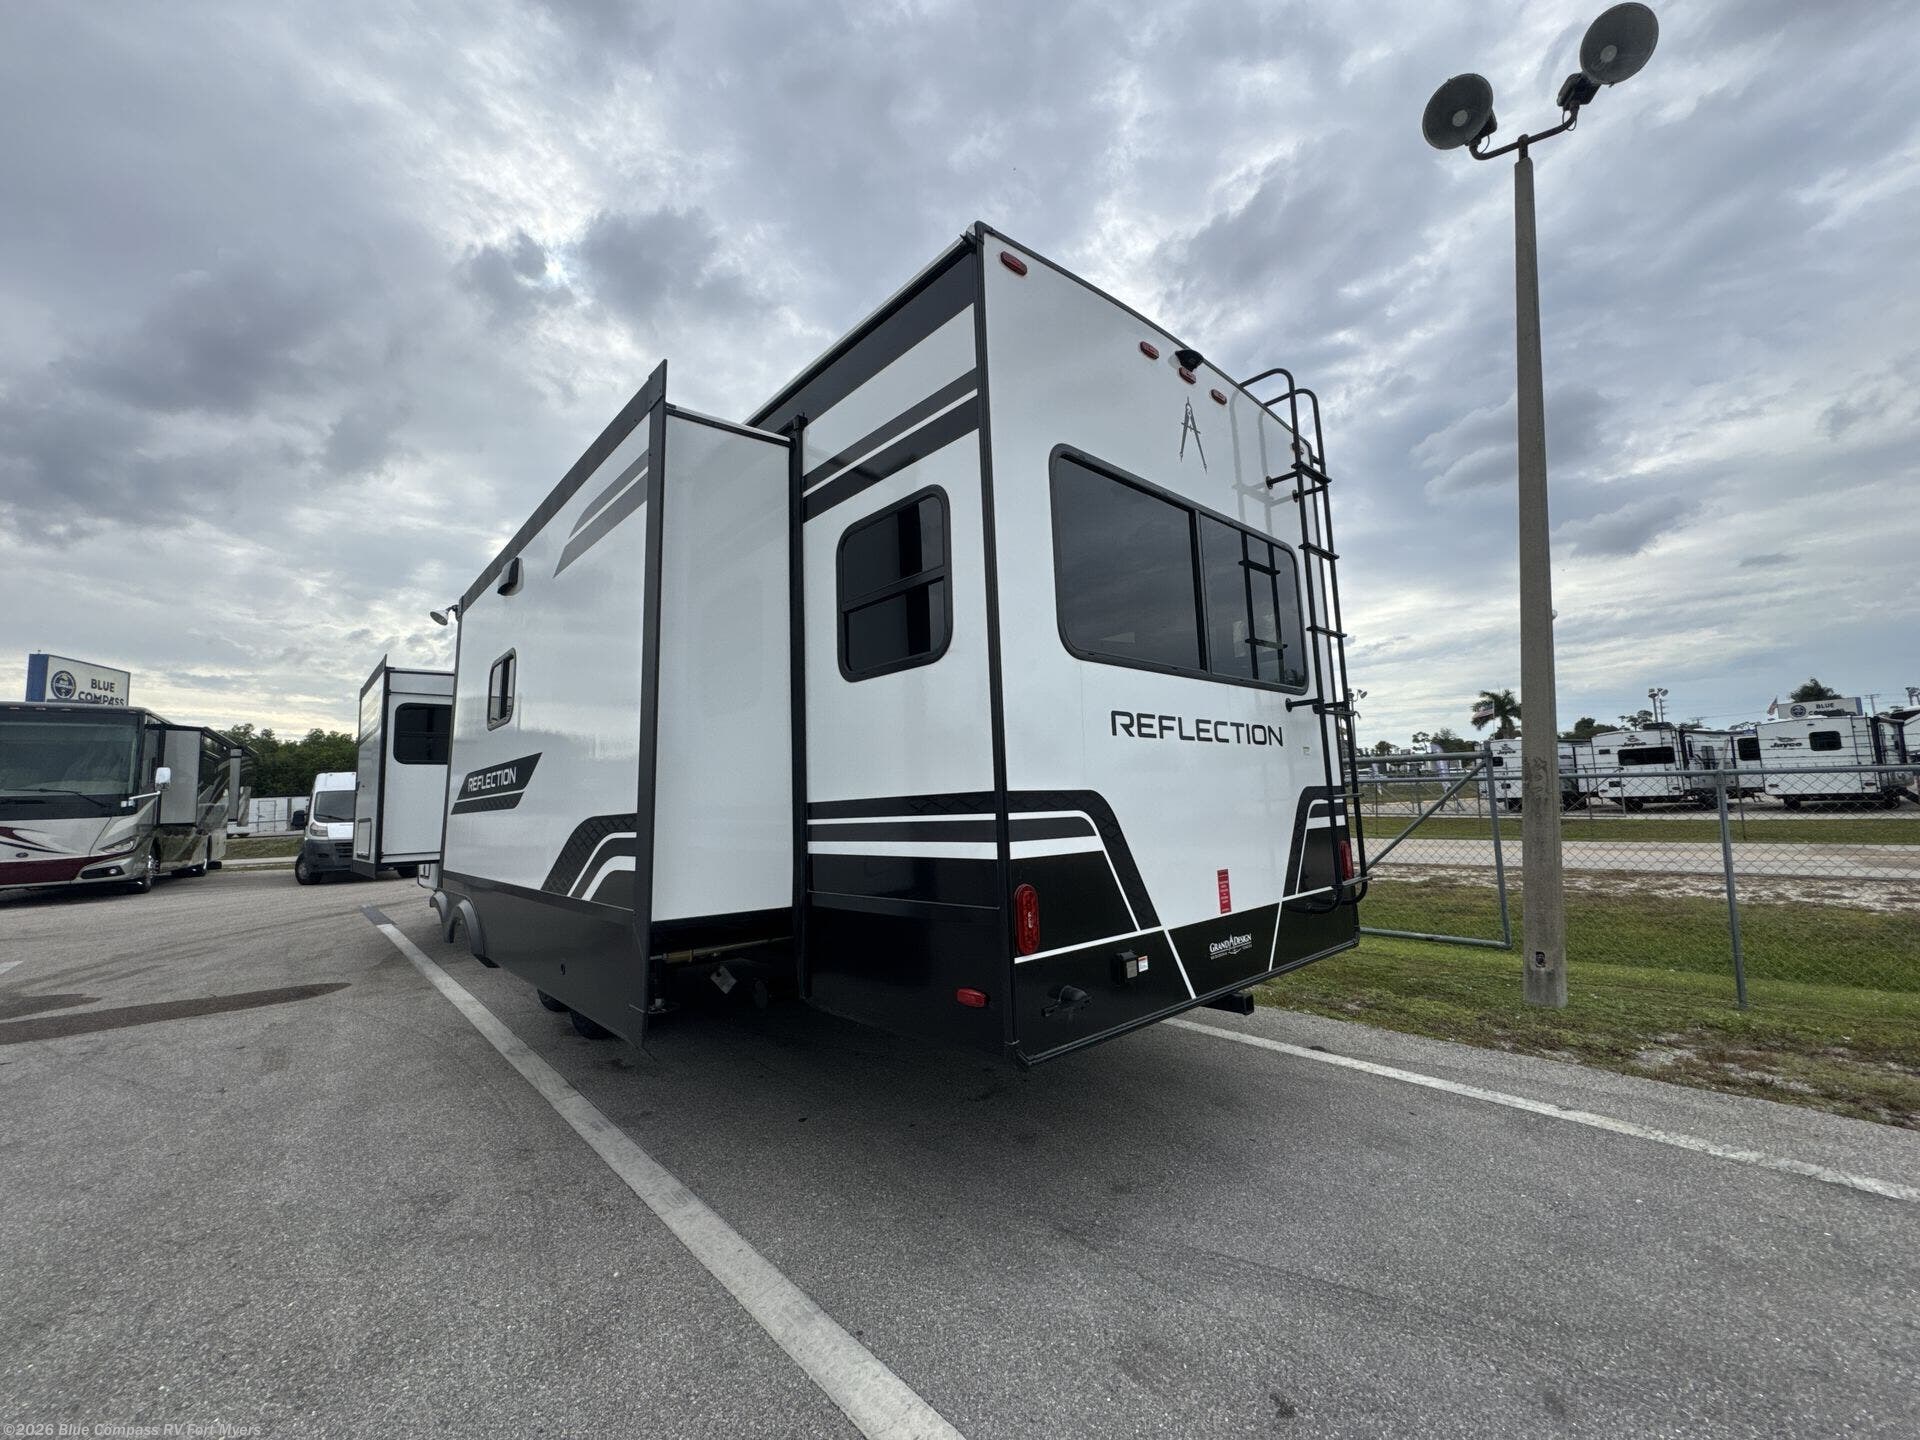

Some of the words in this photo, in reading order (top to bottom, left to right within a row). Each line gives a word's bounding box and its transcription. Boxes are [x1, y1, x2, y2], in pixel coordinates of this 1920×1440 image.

[91, 678, 115, 692] BLUE
[78, 691, 125, 706] COMPASS
[1110, 710, 1283, 747] REFLECTION
[467, 766, 517, 792] REFLECTION
[1209, 940, 1230, 953] GRAND
[1233, 932, 1252, 945] DESIGN
